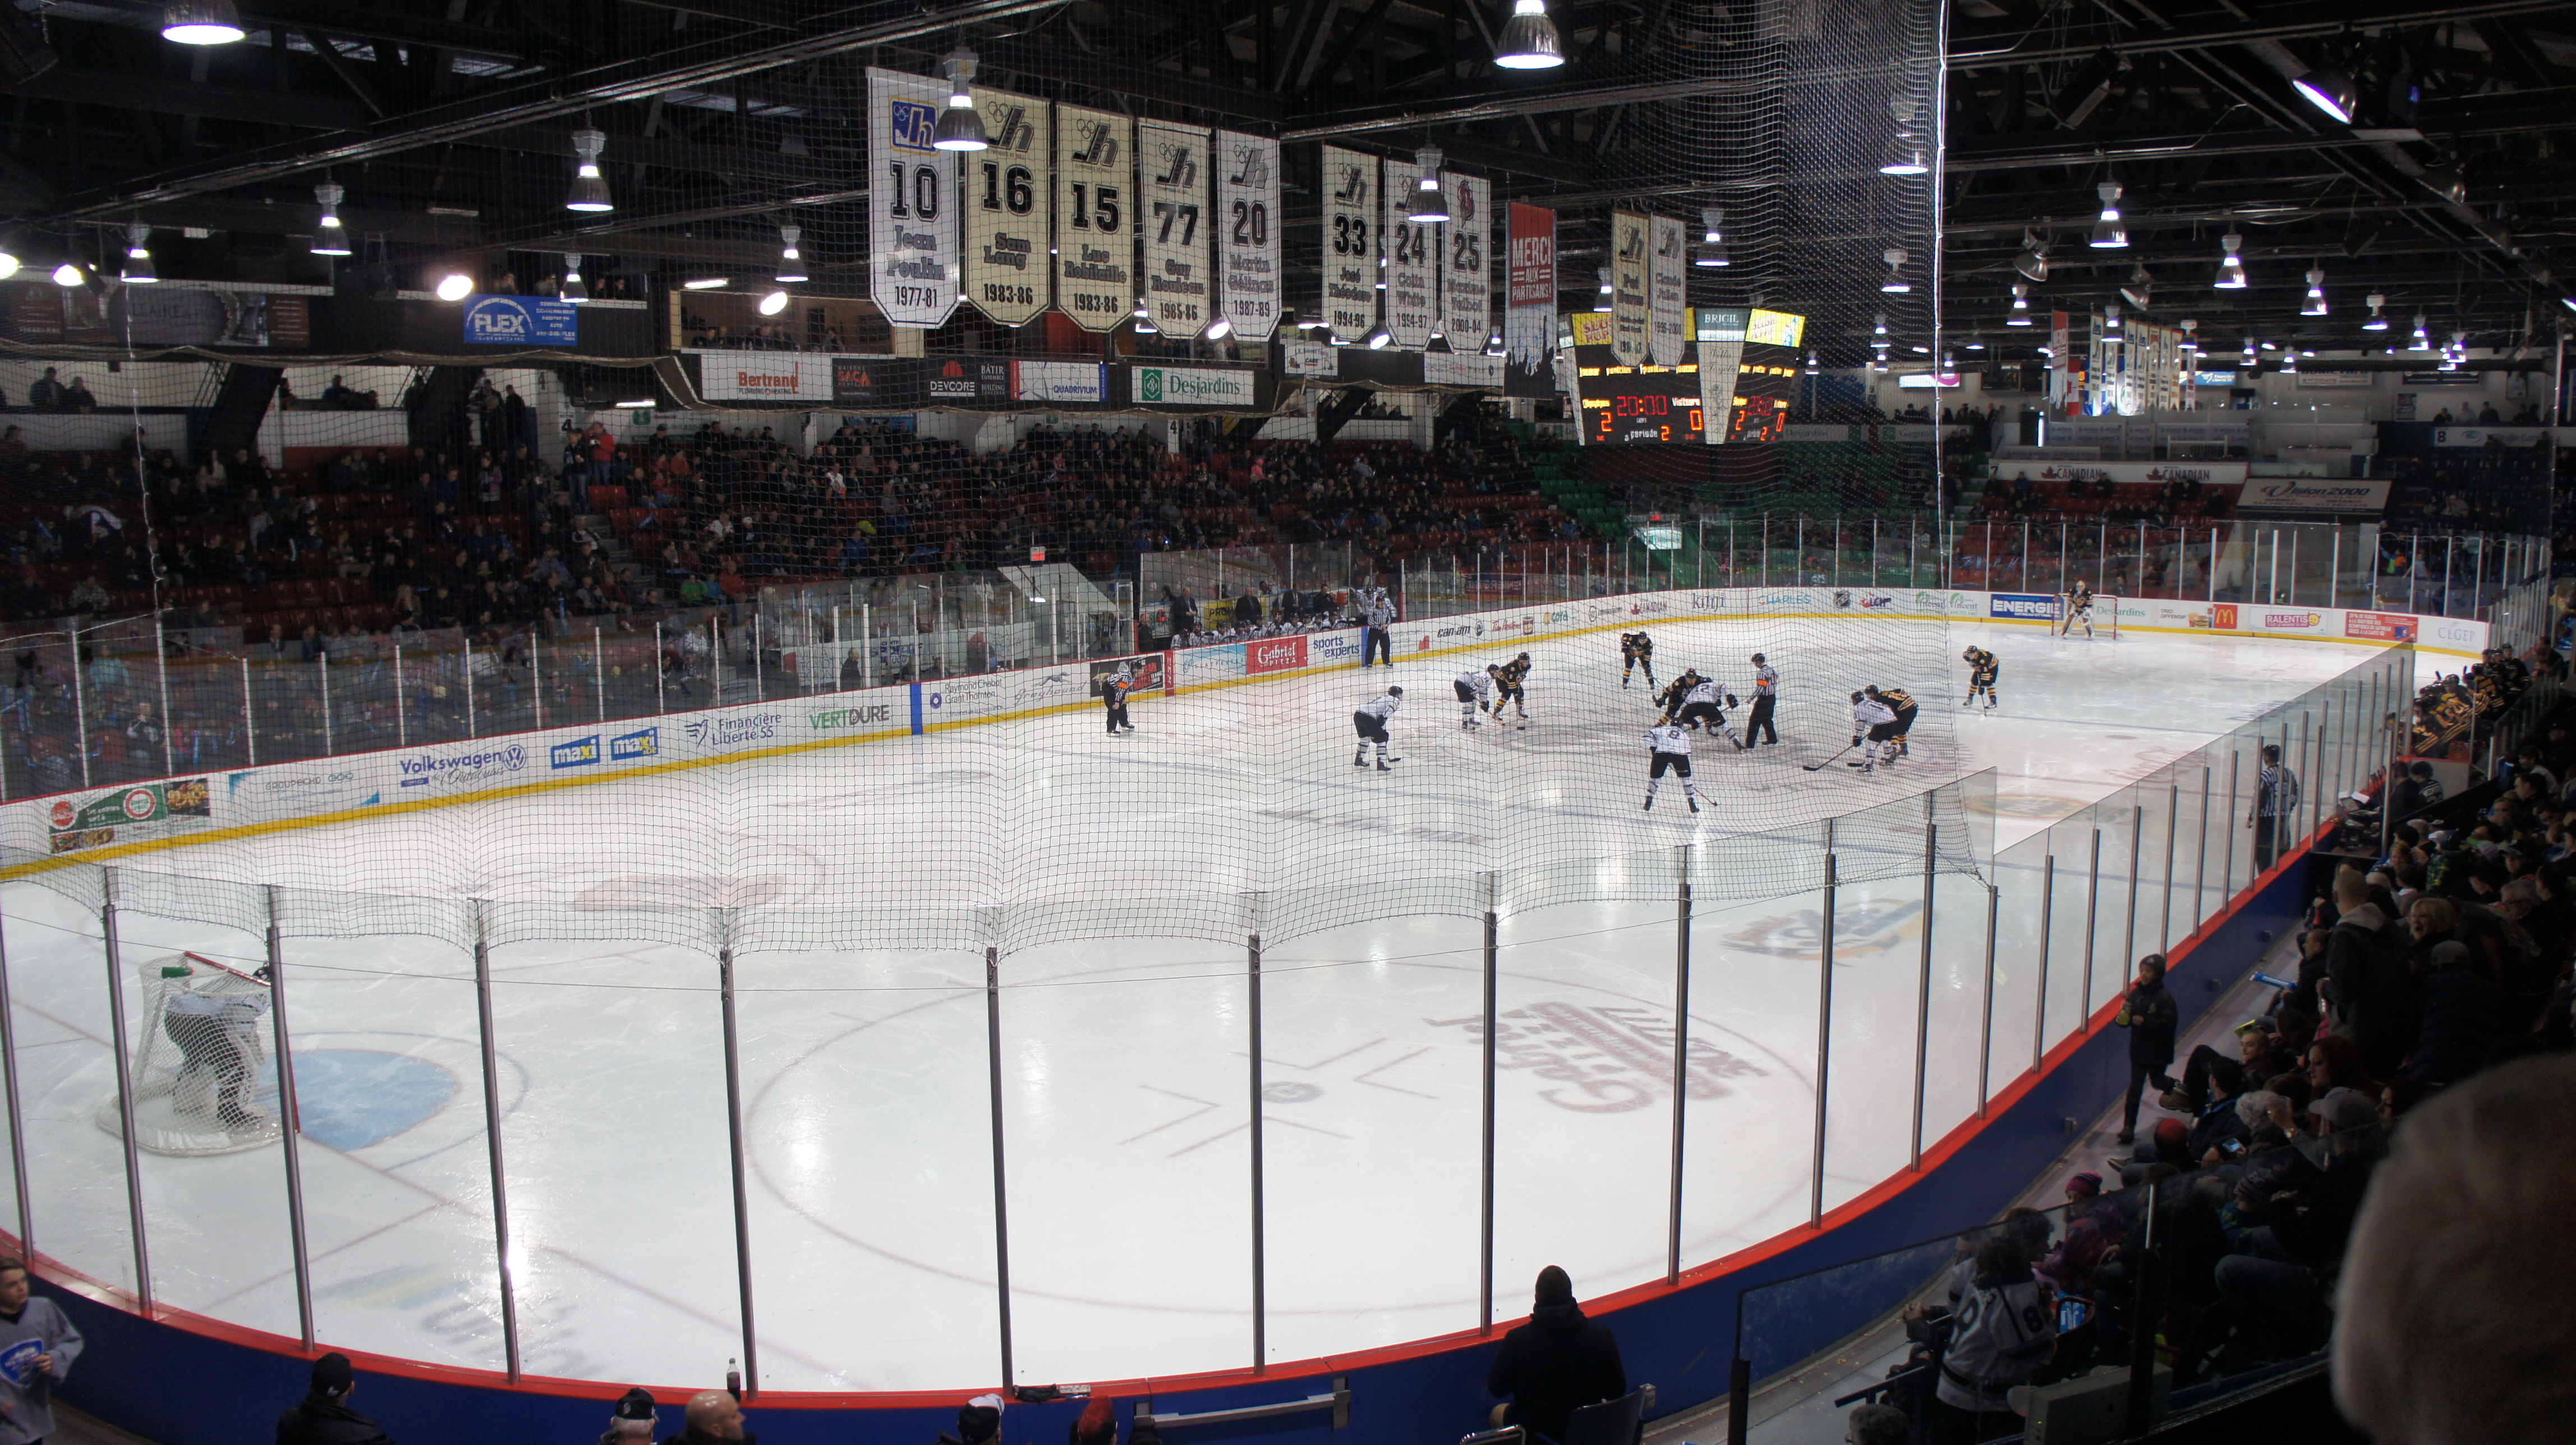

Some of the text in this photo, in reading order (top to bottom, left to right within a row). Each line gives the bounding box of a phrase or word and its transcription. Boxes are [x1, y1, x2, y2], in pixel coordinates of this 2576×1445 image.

[890, 160, 940, 222] 10
[982, 159, 1034, 217] 16
[1071, 181, 1121, 234] 15
[1153, 200, 1198, 247] 77
[1232, 198, 1268, 248] 20
[895, 225, 937, 252] Jean
[995, 232, 1031, 252] Sam
[1333, 213, 1367, 259] 33
[1396, 222, 1425, 267] 24
[984, 245, 1027, 270] Lang
[1082, 244, 1110, 263] Luc
[1453, 231, 1481, 273] 25
[1512, 236, 1551, 268] MERCI
[886, 254, 945, 280] Poulin
[1065, 261, 1126, 283] Robitaille
[1165, 259, 1191, 279] Guy
[1230, 255, 1270, 273] Martin
[1152, 275, 1204, 294] Rouleau
[1228, 274, 1274, 293] Gélinas
[1340, 267, 1361, 283] José
[1397, 272, 1425, 288] Colin
[1525, 268, 1539, 283] AUX
[895, 286, 937, 307] 1977-81
[984, 283, 1033, 305] 1983-86
[1328, 283, 1372, 302] Théodore
[1396, 291, 1426, 307] White
[1512, 283, 1551, 301] PARTISANS!
[1074, 293, 1118, 313] 1983-86
[1160, 302, 1198, 321] 1985-86
[1234, 300, 1270, 317] 1987-89
[1334, 310, 1365, 328] 1994-96
[1397, 312, 1428, 328] 1994-97
[1452, 318, 1481, 333] 2000-04
[1654, 321, 1681, 335] 1996-2000
[1704, 314, 1739, 323] BRIGIL
[738, 361, 799, 394] Bertrand
[981, 363, 1004, 375] BÂTIR
[930, 381, 975, 392] DEVCORE
[1054, 385, 1097, 394] QUADRIVIUM
[1170, 375, 1240, 398] Desjardins
[1617, 395, 1668, 416] 20:00
[562, 419, 572, 431] 4
[1170, 421, 1177, 434] 4
[1601, 411, 1613, 432] 2
[1690, 410, 1702, 430] 0
[1736, 410, 1746, 431] 2
[1661, 425, 1670, 441] 2
[1761, 426, 1768, 441] 2
[2437, 431, 2446, 443] 8
[2261, 481, 2327, 497] Vision
[1692, 592, 1724, 611] kijiji
[1949, 599, 1977, 609] Vincent
[1258, 642, 1296, 664] Gabriel
[1313, 636, 1343, 651] sports
[1325, 644, 1359, 659] experts
[1269, 657, 1296, 666] PIZZA
[945, 678, 1002, 693] Raymond Chabot
[1013, 680, 1087, 706] Greyhound
[945, 691, 995, 703] Grant Thornton
[719, 713, 781, 729] Financière
[614, 730, 655, 755] maxi
[713, 726, 774, 745] Liberté 55
[1669, 728, 1680, 739] 8
[554, 738, 596, 764] maxi
[399, 751, 502, 774] Volkswagen
[2022, 1304, 2045, 1333] 8
